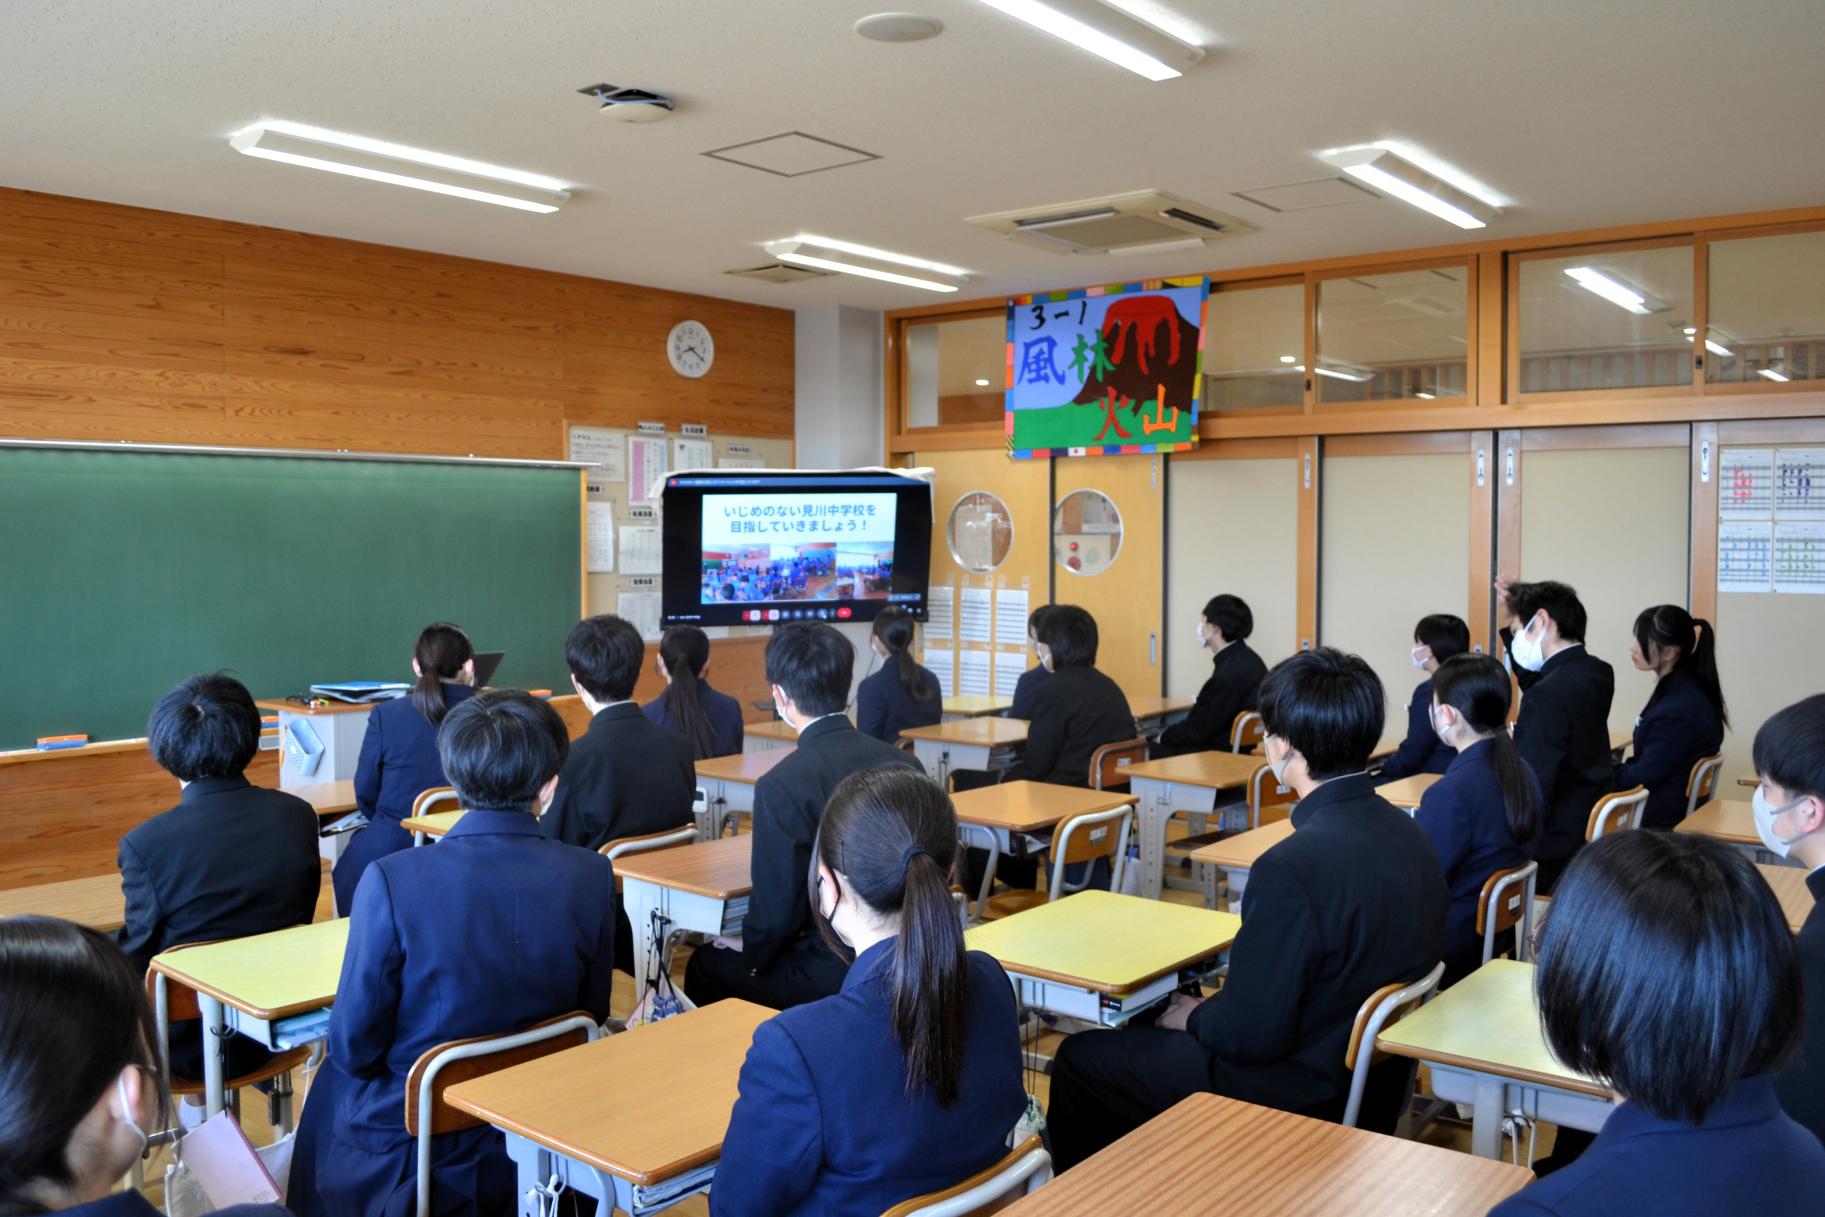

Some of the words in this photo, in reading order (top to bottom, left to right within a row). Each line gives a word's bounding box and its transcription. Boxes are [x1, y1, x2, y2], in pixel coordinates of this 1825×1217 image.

[1030, 300, 1087, 330] 3-1
[1017, 329, 1116, 385] 風林
[1094, 384, 1179, 441] 火山
[724, 504, 877, 518] いじめのない見川中学校を
[730, 519, 867, 533] 目指していきましょう！
